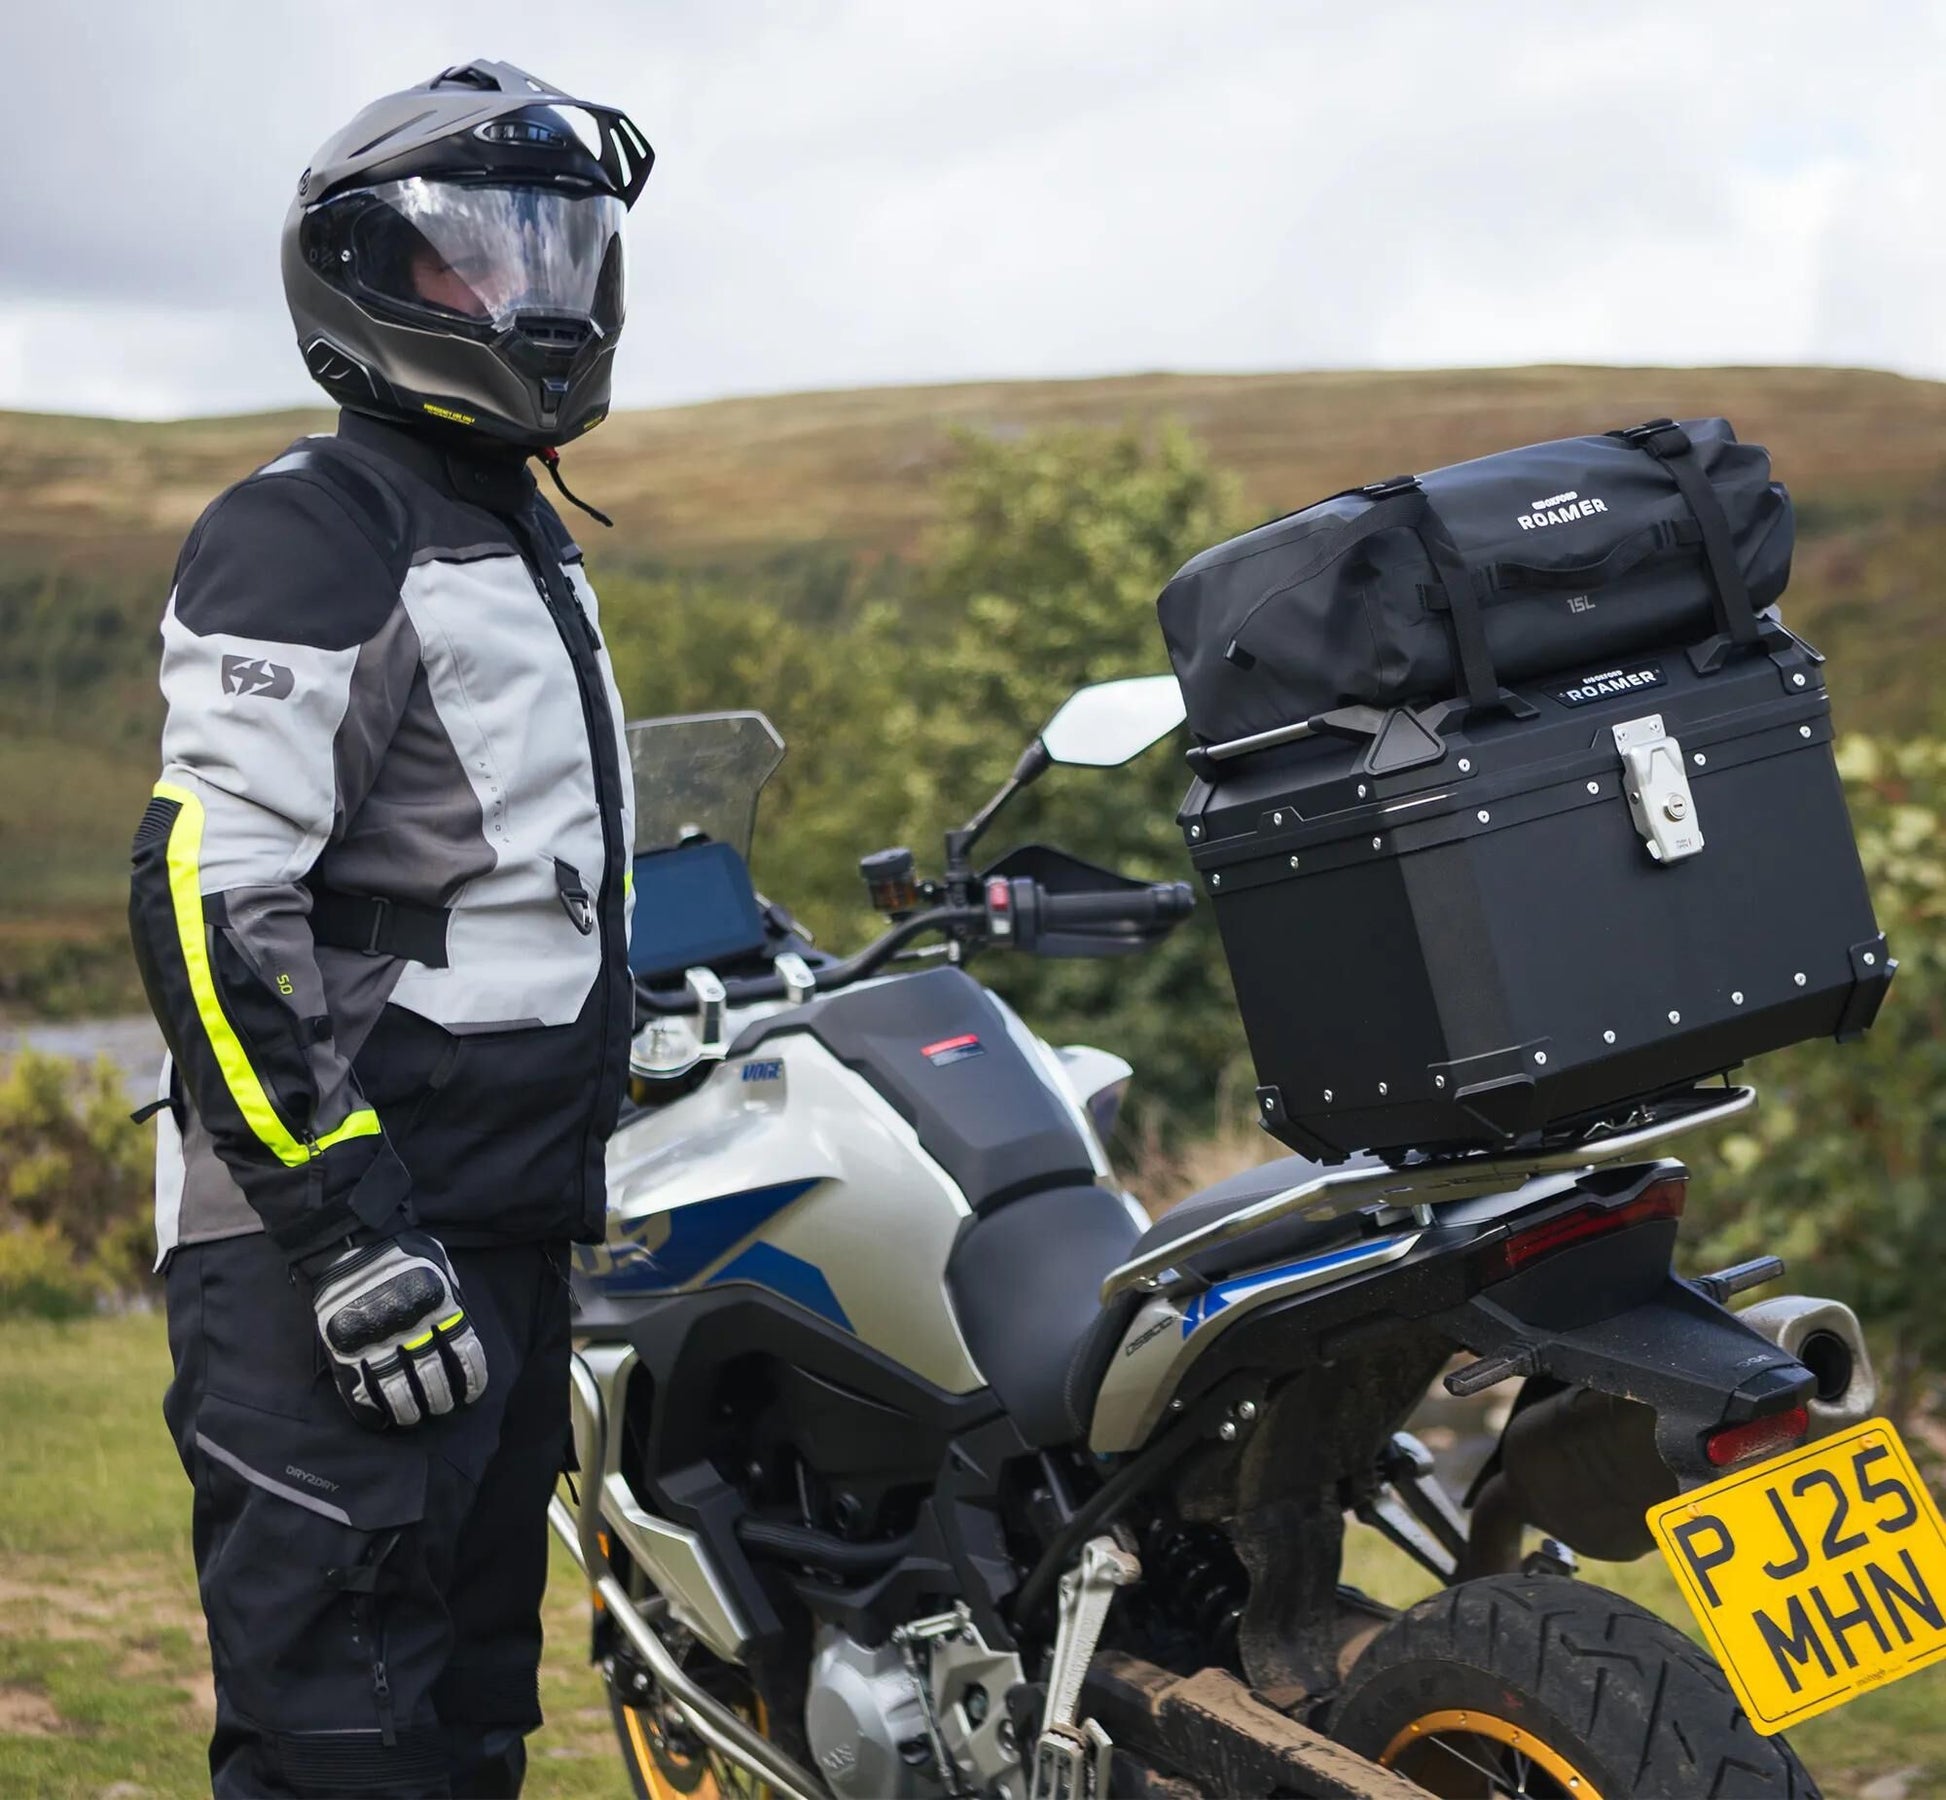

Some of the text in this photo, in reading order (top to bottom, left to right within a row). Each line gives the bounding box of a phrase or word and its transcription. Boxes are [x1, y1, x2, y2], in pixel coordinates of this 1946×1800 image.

[1517, 498, 1609, 530] ROAMER
[1567, 595, 1596, 613] 15L
[1566, 671, 1657, 701] ROAMER
[286, 1465, 340, 1492] DRY2DRY
[1751, 1548, 1946, 1694] MHN
